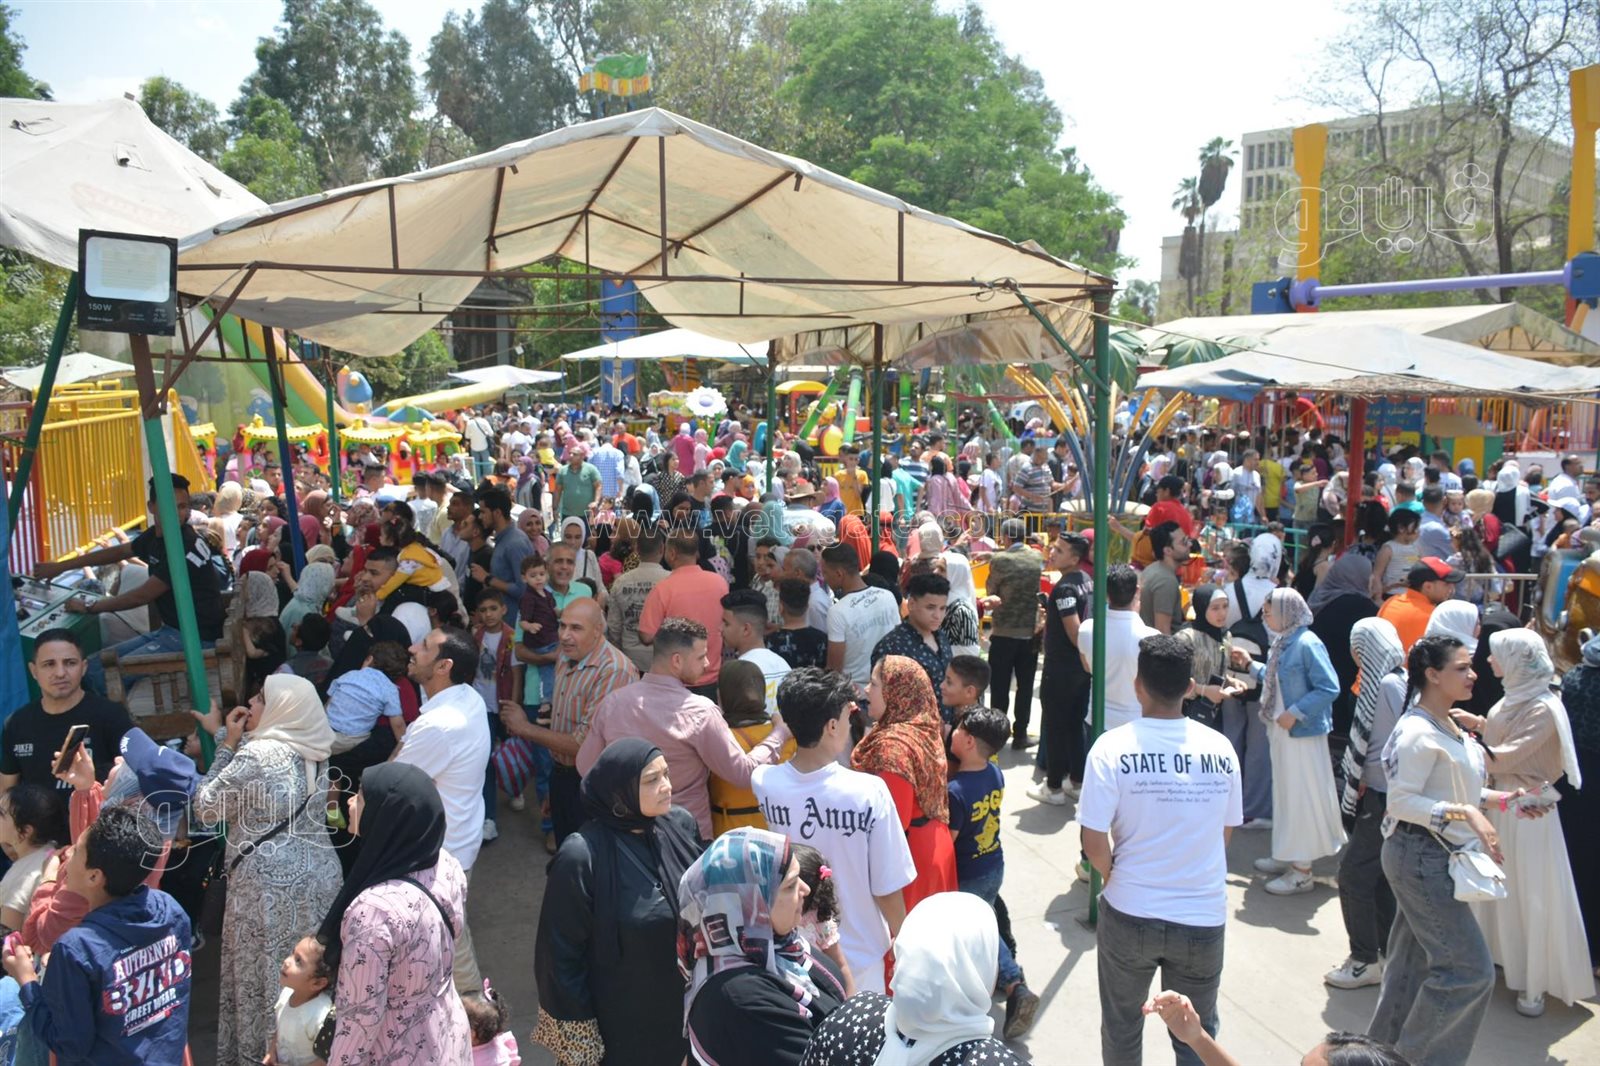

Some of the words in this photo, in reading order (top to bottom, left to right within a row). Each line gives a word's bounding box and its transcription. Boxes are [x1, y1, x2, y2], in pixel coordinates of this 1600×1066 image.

[1120, 753, 1167, 774] STATE
[1174, 753, 1192, 773] OF
[124, 1001, 152, 1025] STREET
[153, 987, 177, 1010] WEAR
